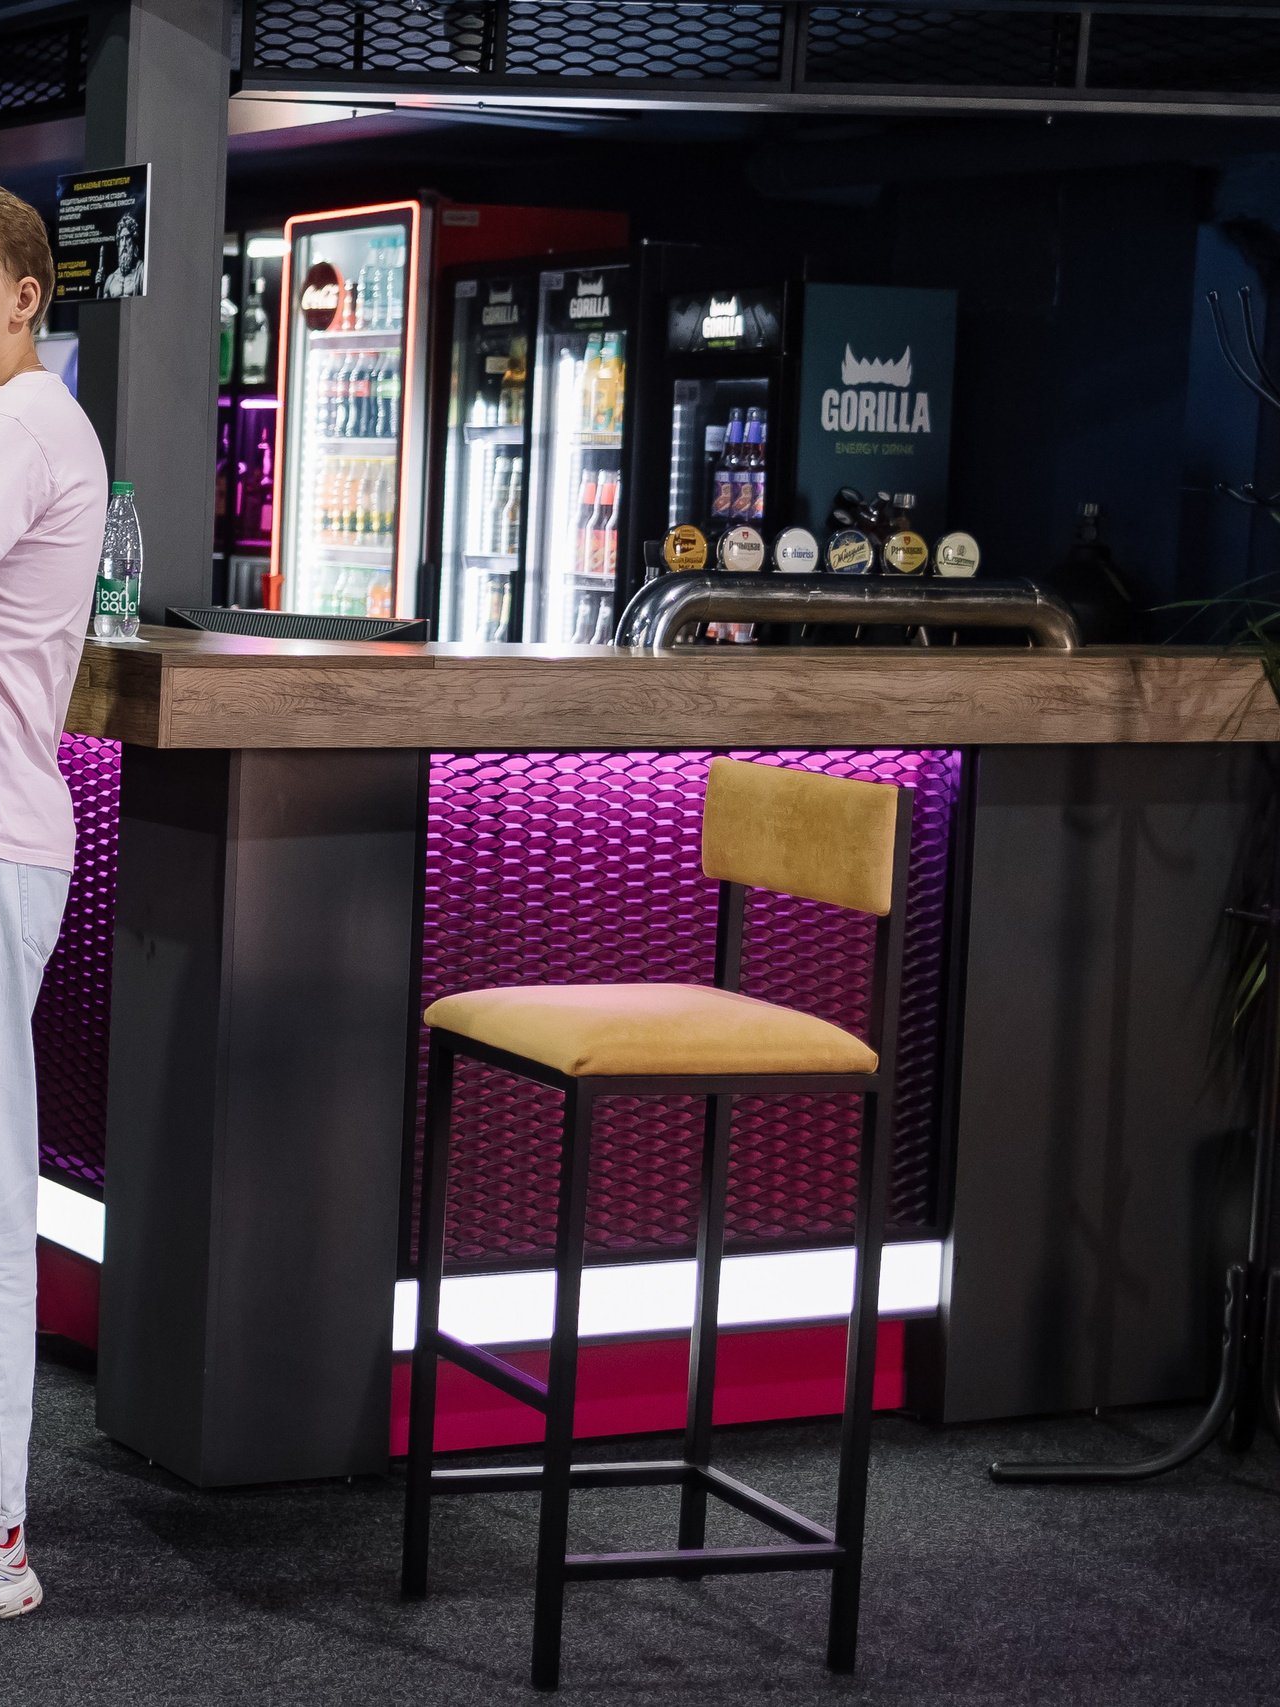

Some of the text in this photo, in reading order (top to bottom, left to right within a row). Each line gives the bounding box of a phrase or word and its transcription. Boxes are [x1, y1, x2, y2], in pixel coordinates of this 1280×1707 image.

[482, 304, 519, 326] GORILLA
[569, 296, 610, 319] GORILLA
[702, 315, 744, 338] GORILLA
[821, 388, 931, 433] GORILLA
[835, 442, 914, 455] ENERGY DRINK
[101, 601, 136, 614] aqua
